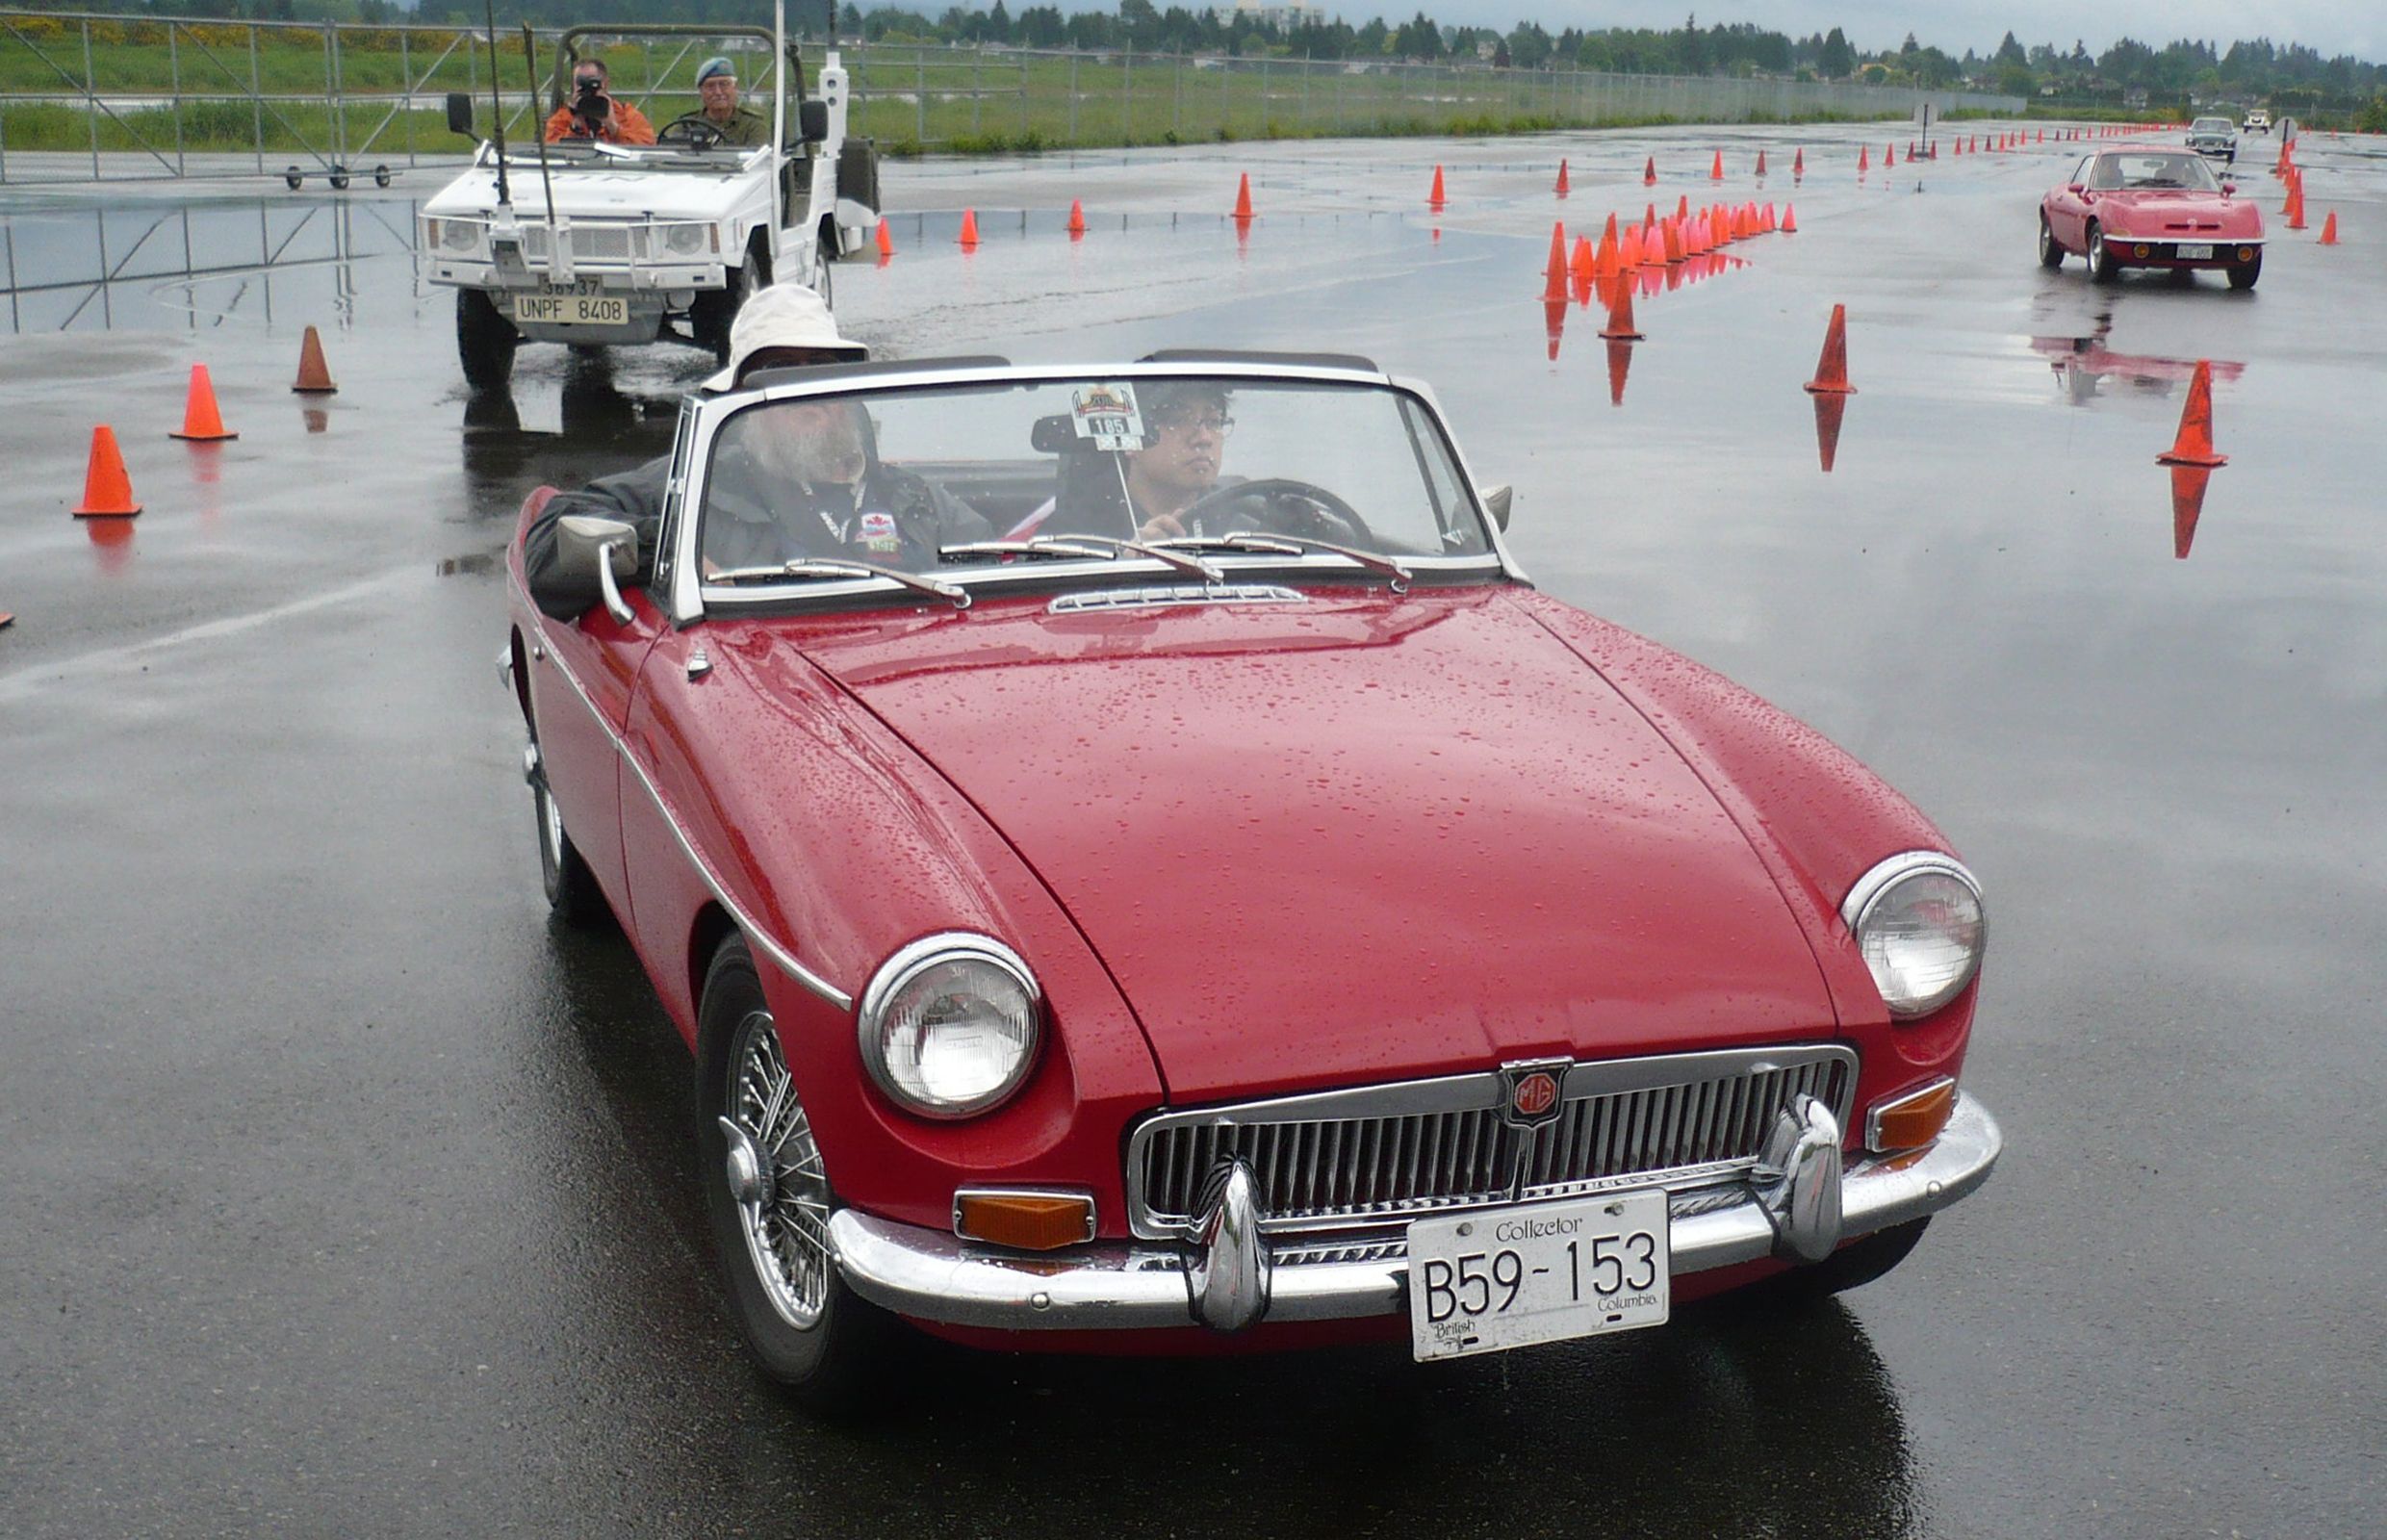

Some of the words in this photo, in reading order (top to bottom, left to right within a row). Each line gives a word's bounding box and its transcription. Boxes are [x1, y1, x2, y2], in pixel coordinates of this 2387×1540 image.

[520, 297, 563, 320] UNPF
[578, 299, 622, 321] 8408
[1519, 1077, 1553, 1110] MG
[1495, 1217, 1583, 1243] Collector
[1434, 1319, 1476, 1339] British
[1597, 1293, 1658, 1313] Columbia
